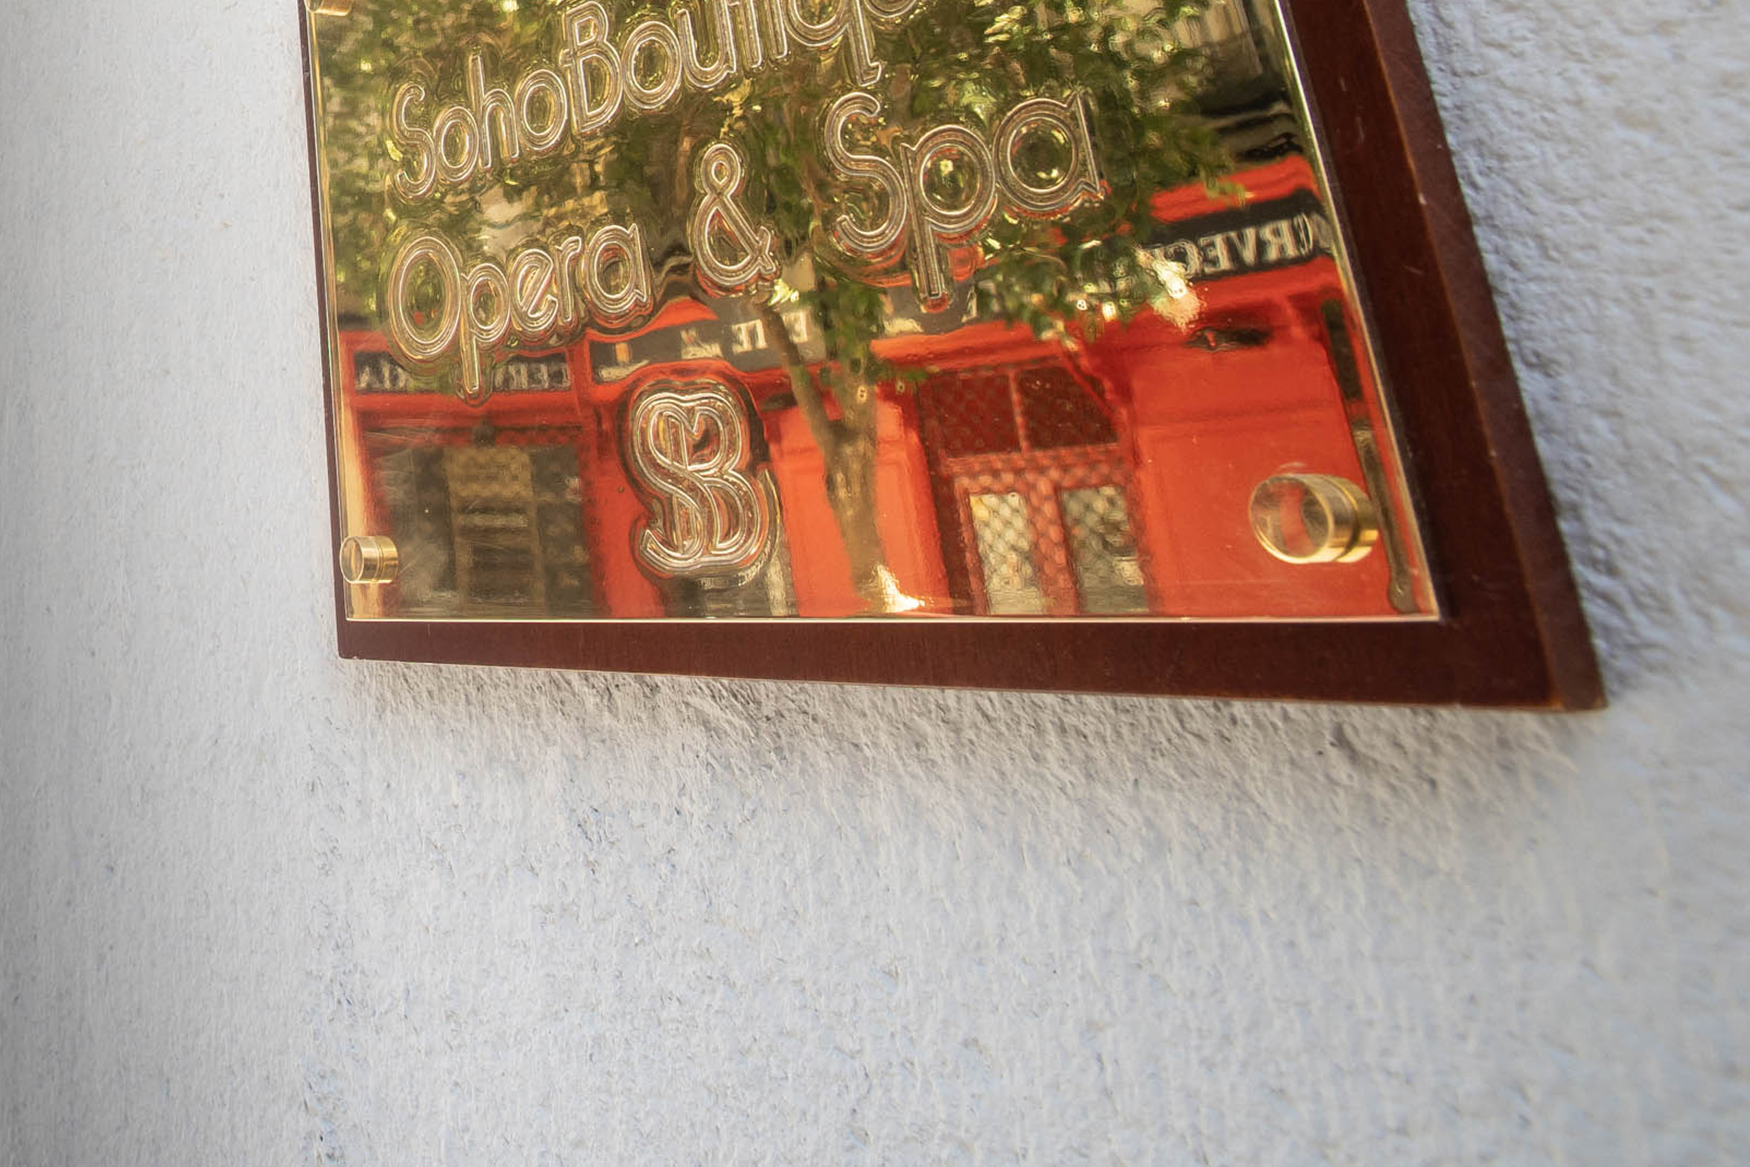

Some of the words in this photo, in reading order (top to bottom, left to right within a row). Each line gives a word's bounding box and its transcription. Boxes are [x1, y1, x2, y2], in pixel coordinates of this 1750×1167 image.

[389, 221, 649, 394] Opera
[694, 141, 778, 288] &
[832, 89, 1105, 300] Spa
